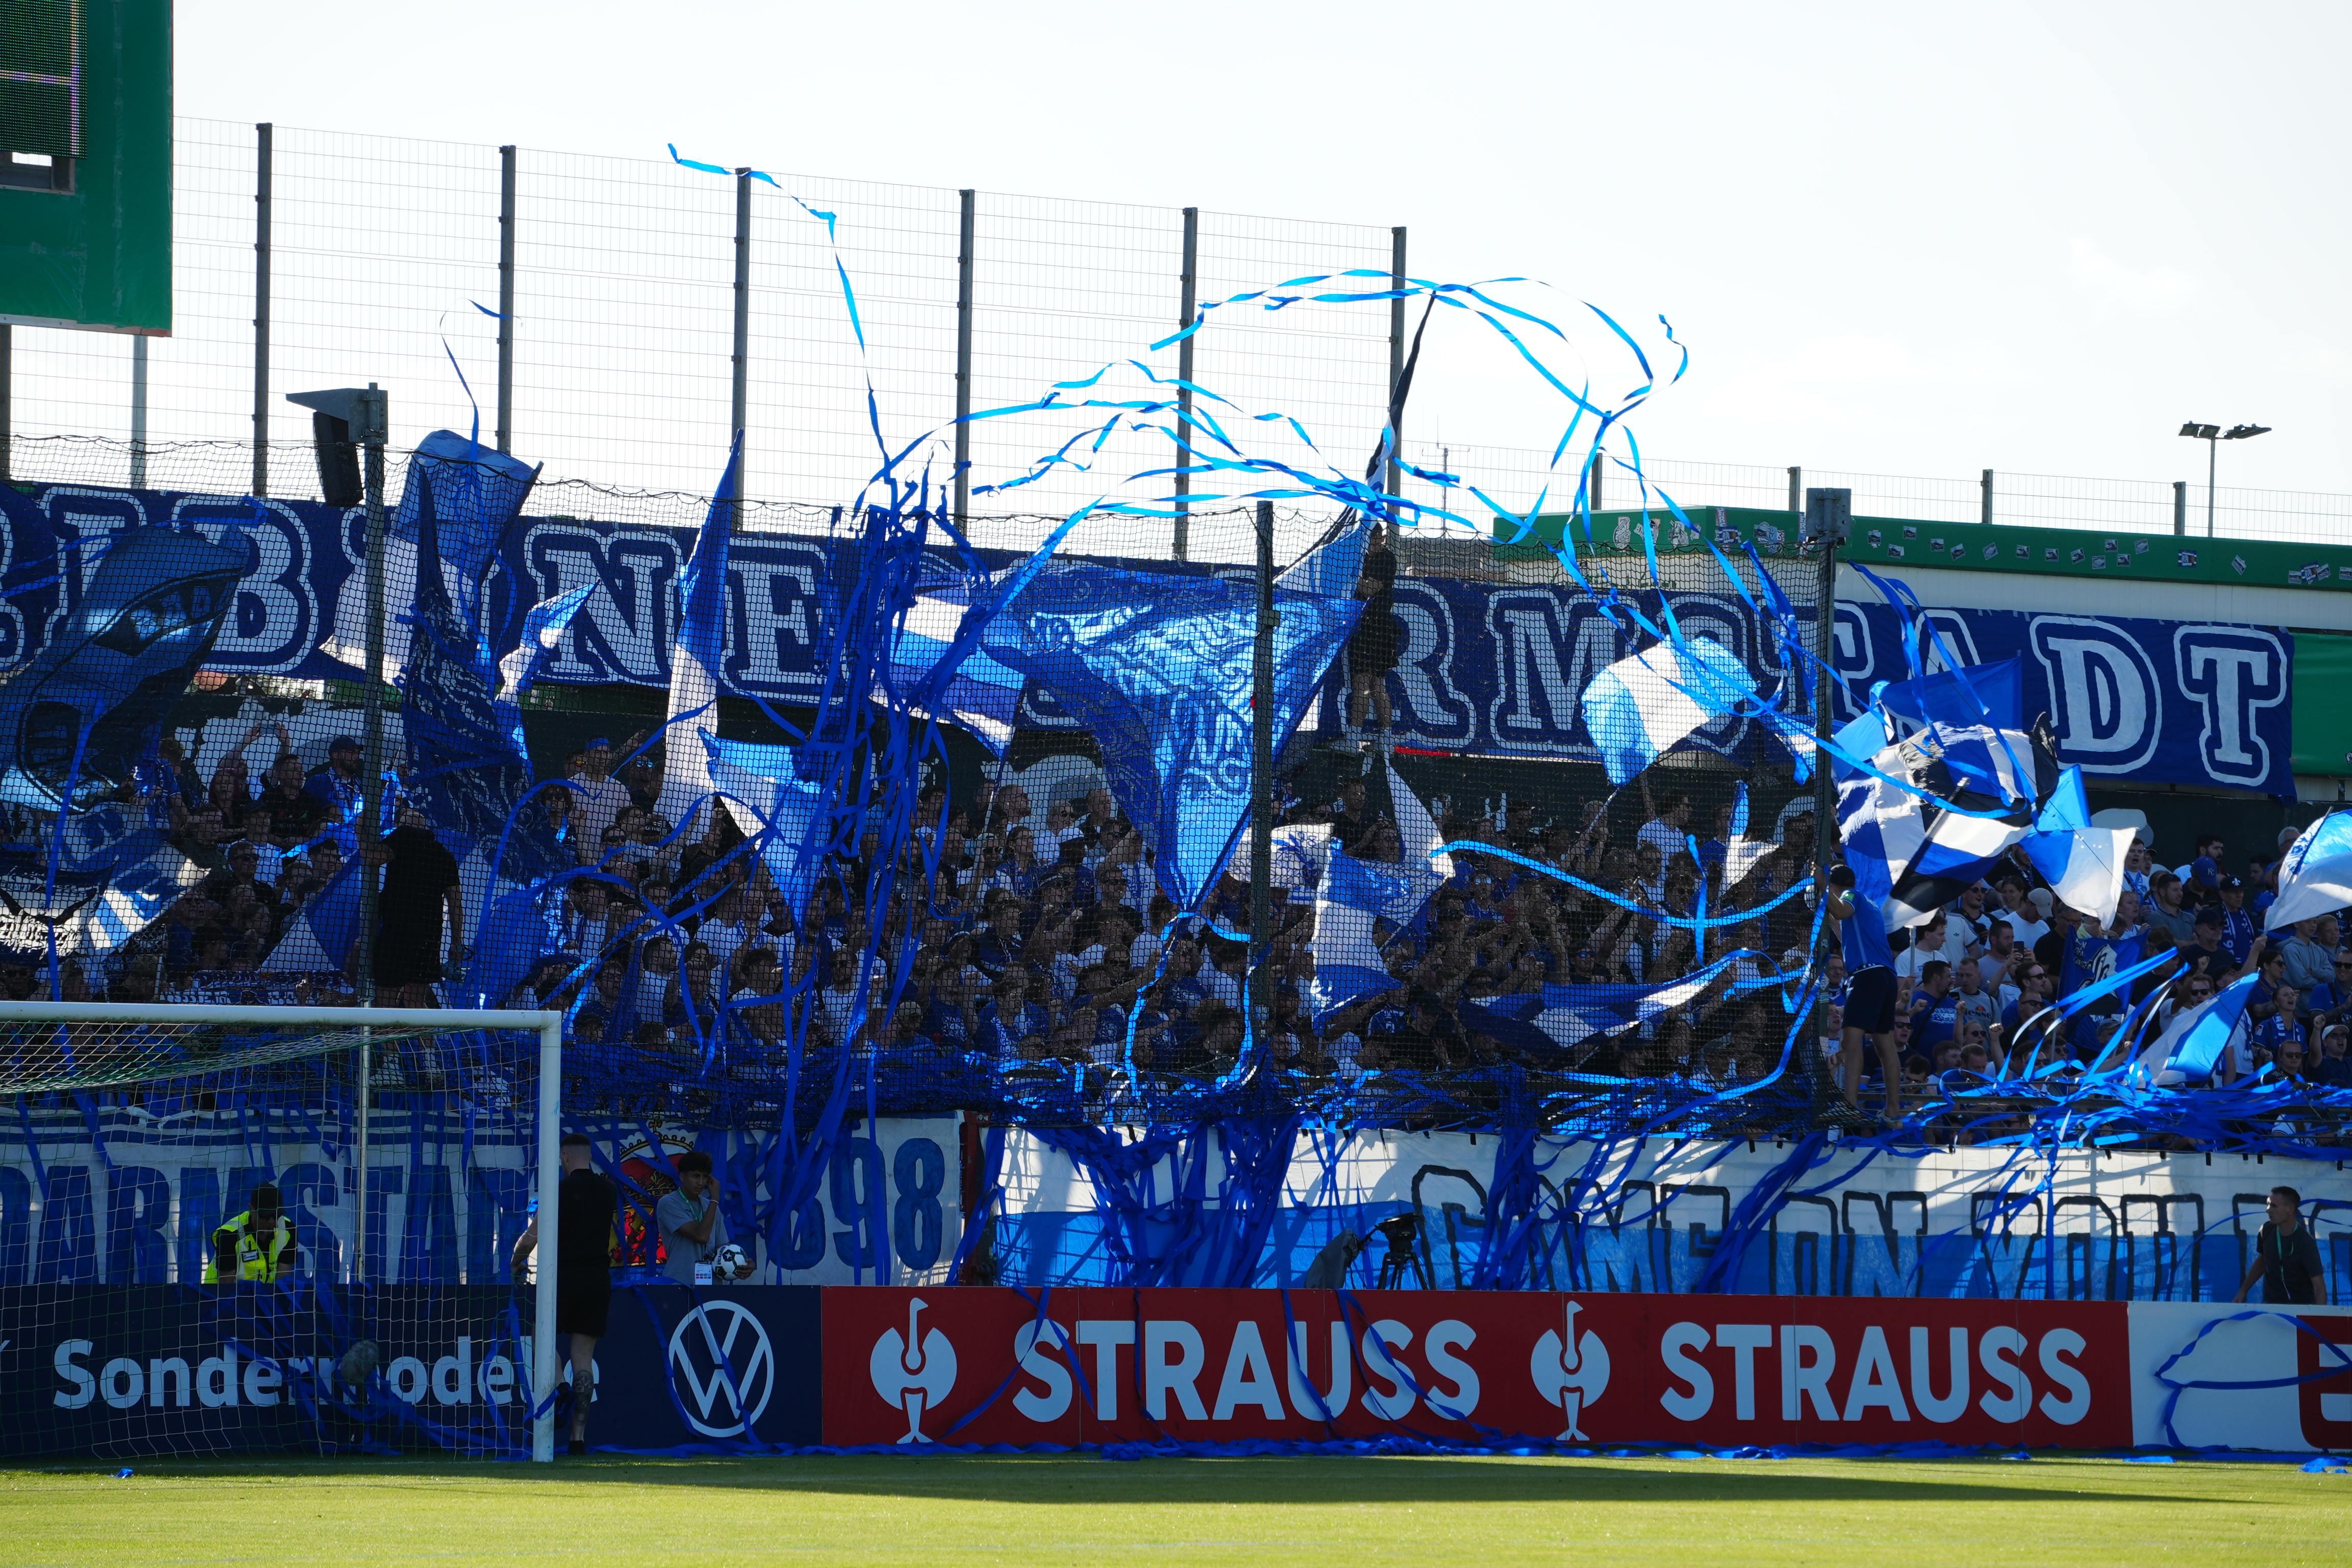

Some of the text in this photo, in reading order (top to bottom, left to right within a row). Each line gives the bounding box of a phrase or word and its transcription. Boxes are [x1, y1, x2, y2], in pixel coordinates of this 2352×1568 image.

[0, 1163, 540, 1284] DARMSTAD
[54, 1336, 599, 1409] Sonderodel
[1013, 1319, 1480, 1424] STRAUSS
[1660, 1321, 2091, 1426] STRAUSS
